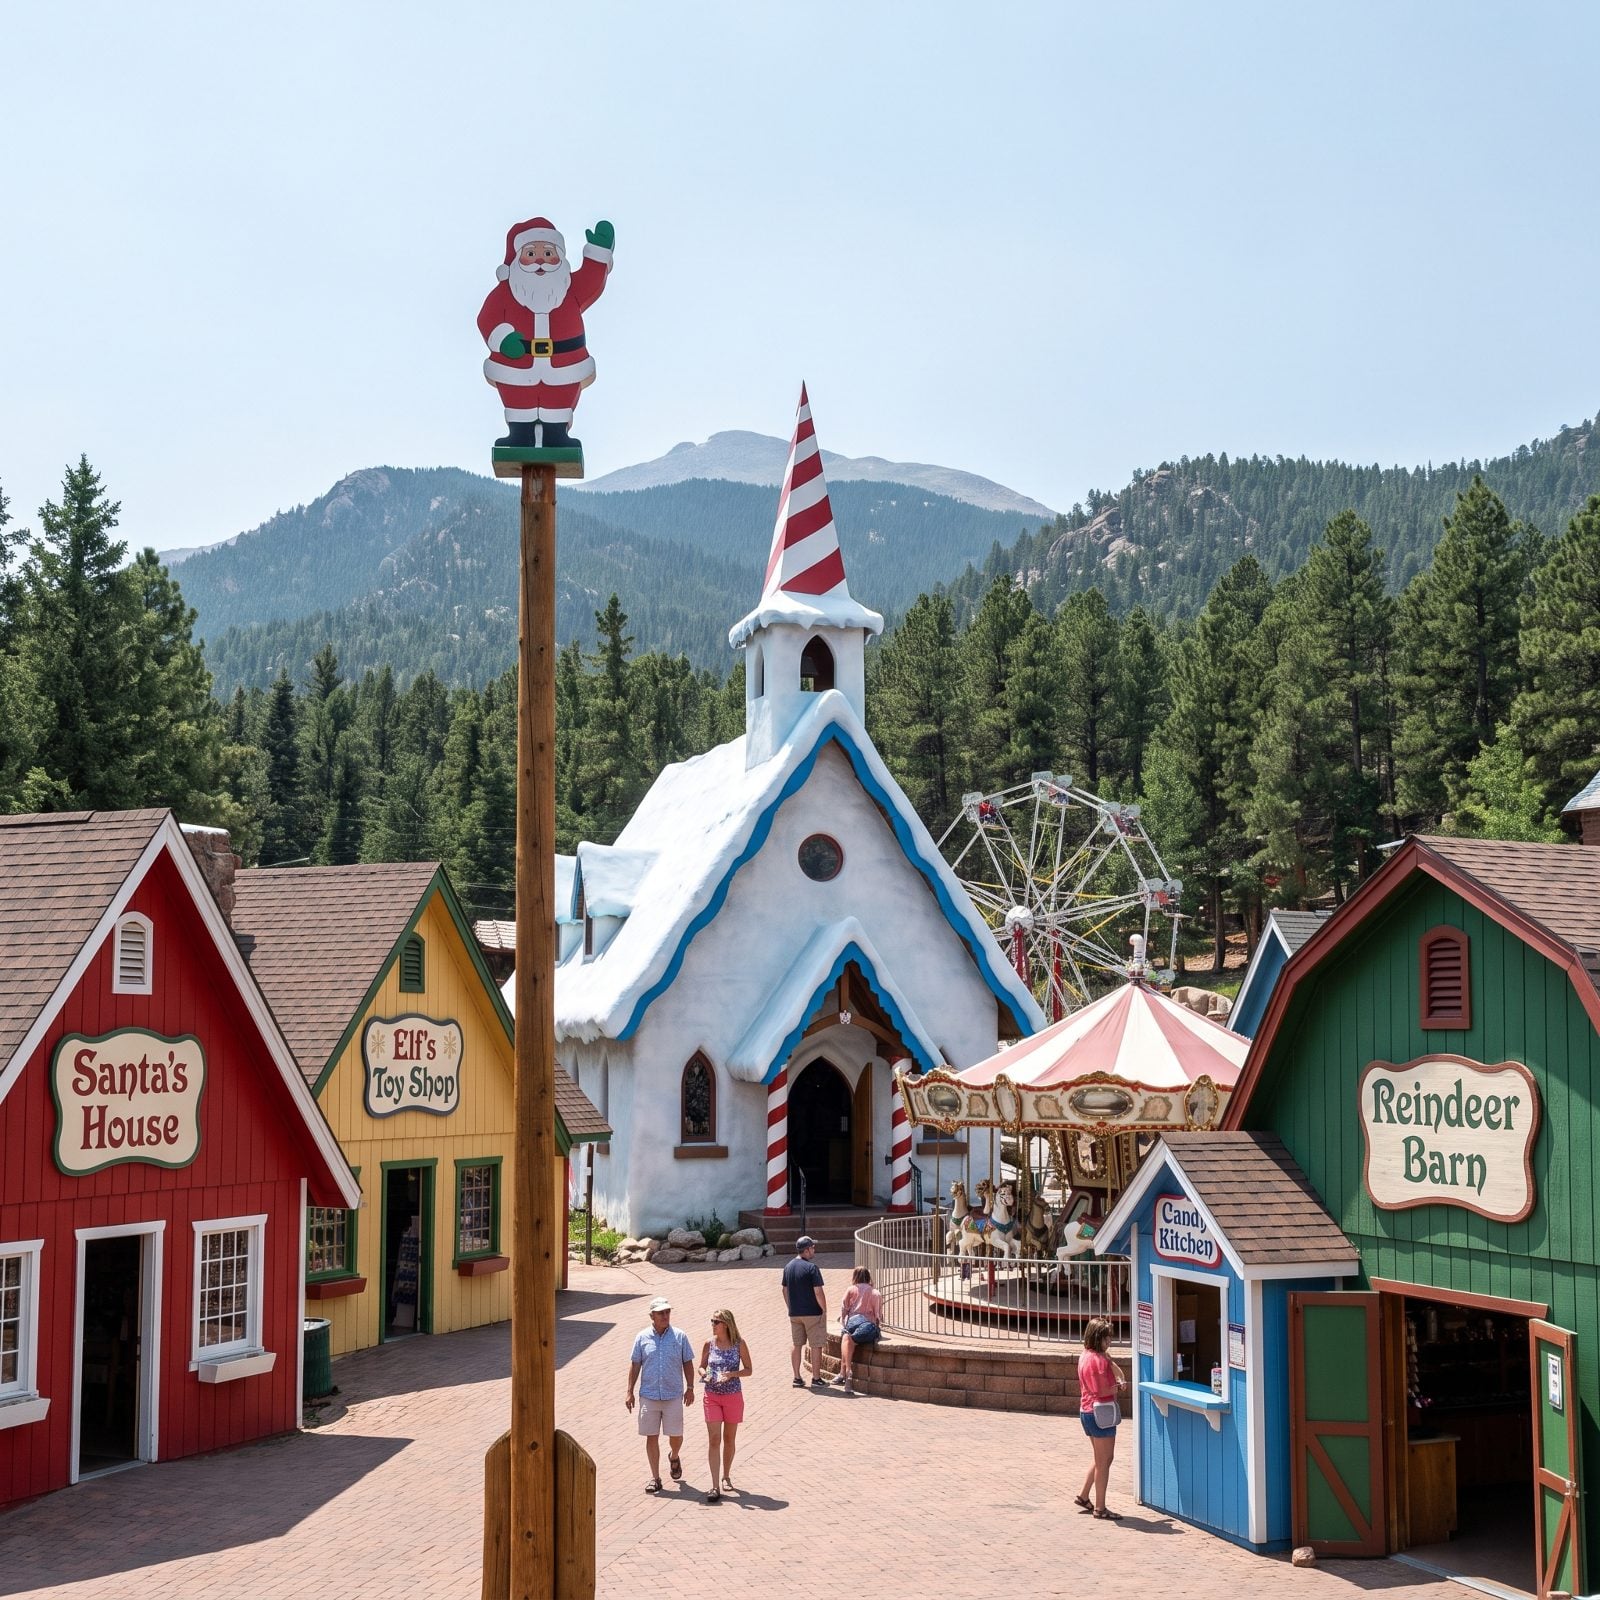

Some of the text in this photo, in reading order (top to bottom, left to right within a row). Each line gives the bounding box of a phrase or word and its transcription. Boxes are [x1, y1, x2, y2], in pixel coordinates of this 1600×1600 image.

[393, 1028, 436, 1060] Elf's
[72, 1049, 188, 1101] Santa's
[373, 1066, 454, 1104] Toy Shop
[80, 1105, 179, 1149] House
[1372, 1078, 1520, 1134] Reindeer
[1402, 1135, 1487, 1196] Barn
[1159, 1228, 1213, 1260] Kitchen
